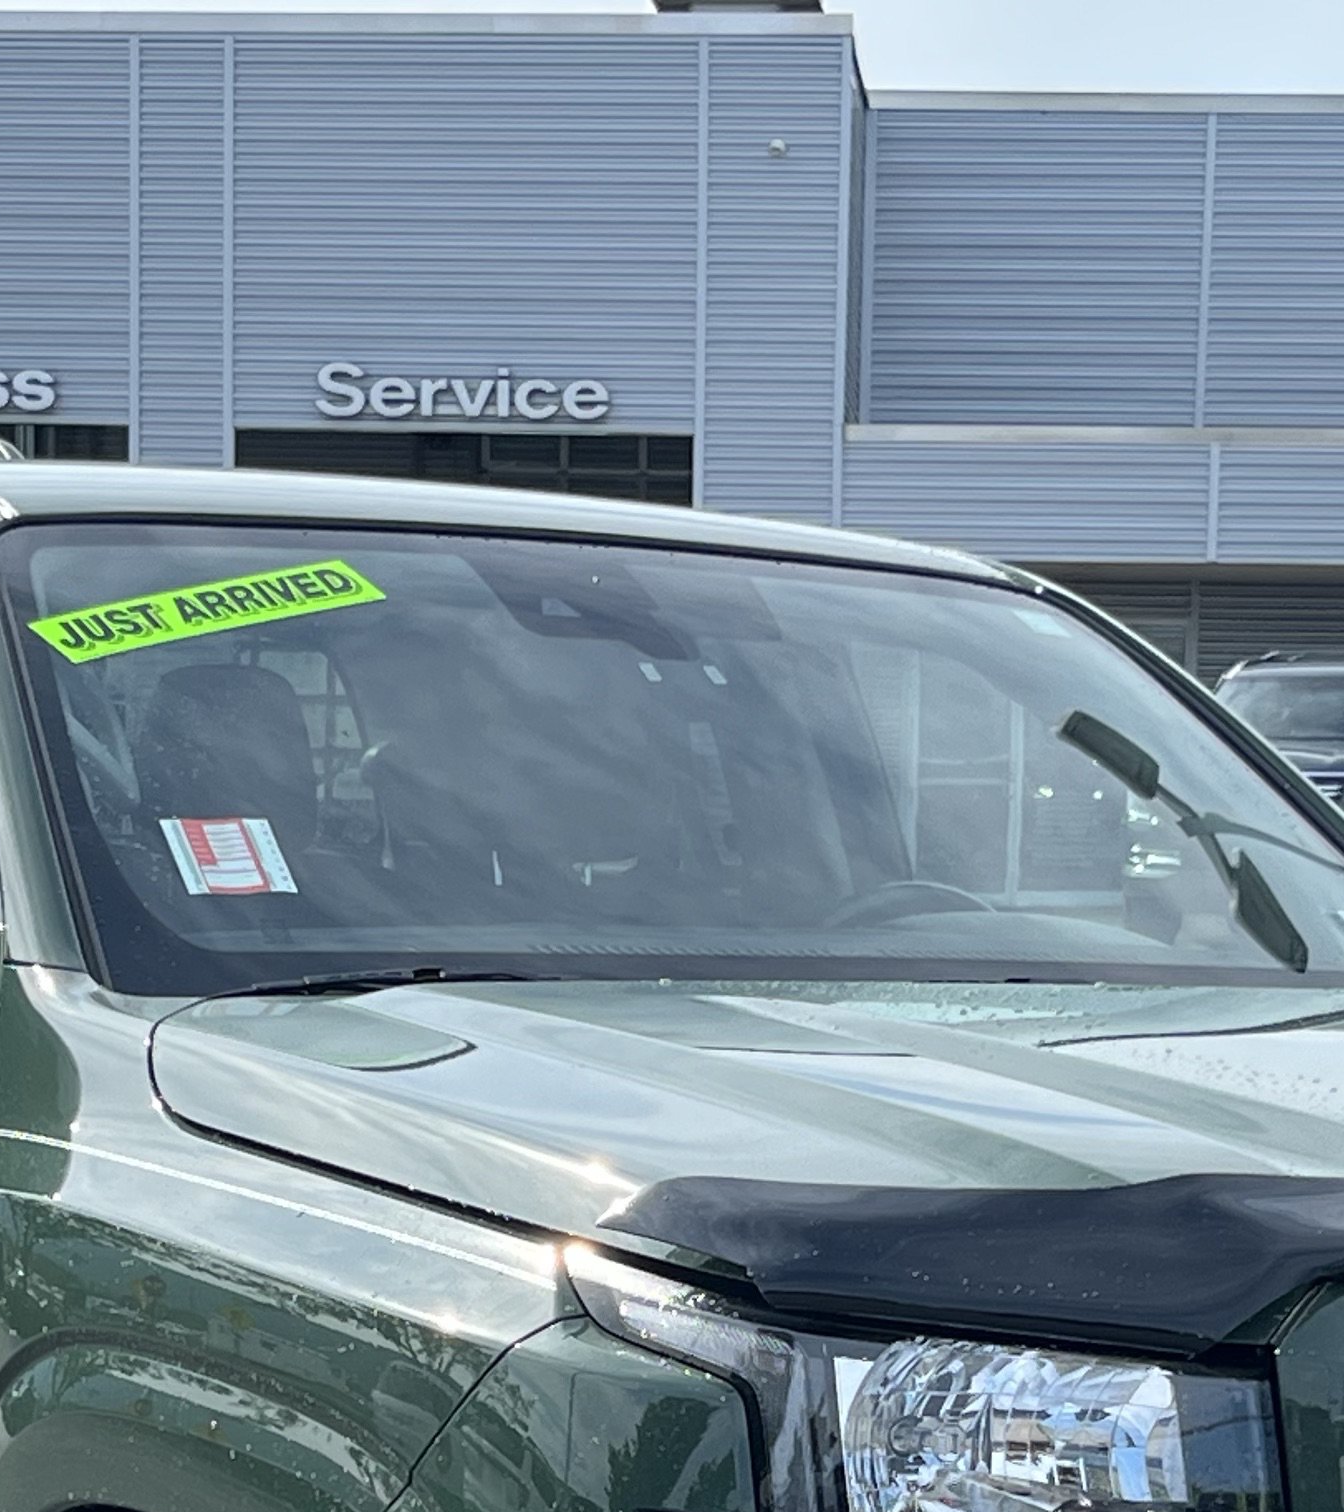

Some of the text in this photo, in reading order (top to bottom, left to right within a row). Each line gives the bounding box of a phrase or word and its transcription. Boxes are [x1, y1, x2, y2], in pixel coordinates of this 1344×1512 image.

[315, 361, 609, 420] Service
[58, 568, 361, 651] JUST ARRIVED
